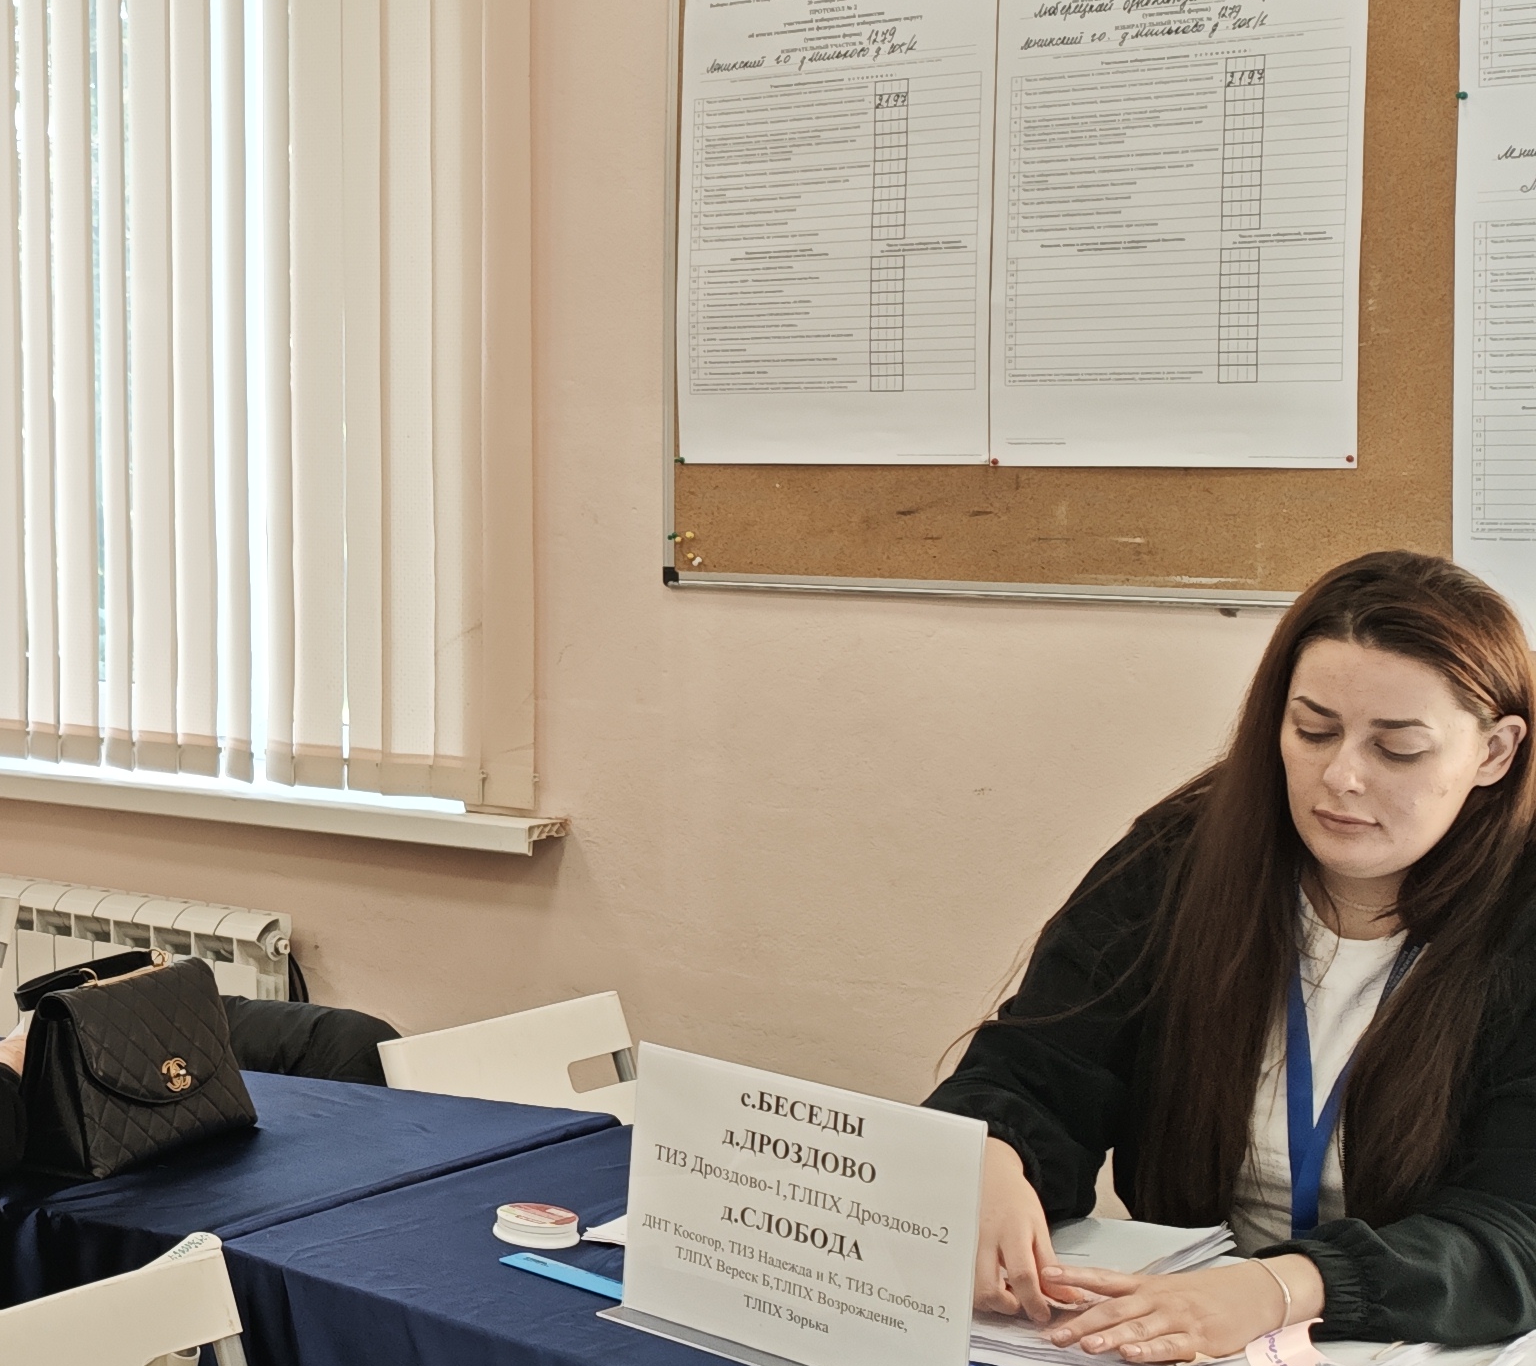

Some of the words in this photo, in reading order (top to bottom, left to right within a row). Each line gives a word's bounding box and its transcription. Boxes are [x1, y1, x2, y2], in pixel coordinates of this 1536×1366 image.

[740, 1090, 866, 1138] с.БЕСЕДЫ
[722, 1129, 877, 1184] д.ДРОЗДОВО
[654, 1143, 688, 1168] ТИЗ
[846, 1200, 950, 1245] Дроздово-2
[720, 1205, 864, 1262] д.СЛОБОДА
[642, 1213, 671, 1233] ДНТ
[673, 1223, 725, 1252] Косогор,
[728, 1240, 755, 1260] ТИЗ
[758, 1249, 813, 1278] Надежда
[816, 1270, 824, 1282] и
[828, 1271, 841, 1289] К,
[846, 1276, 874, 1297] ТИЗ
[877, 1286, 934, 1316] Слобода
[937, 1305, 950, 1323] 2,
[675, 1246, 713, 1269] ТЛПХ
[716, 1259, 759, 1284] Вереск
[817, 1291, 908, 1333] Возрождение,
[743, 1294, 782, 1319] ТЛПХ
[785, 1308, 829, 1334] Зорька
